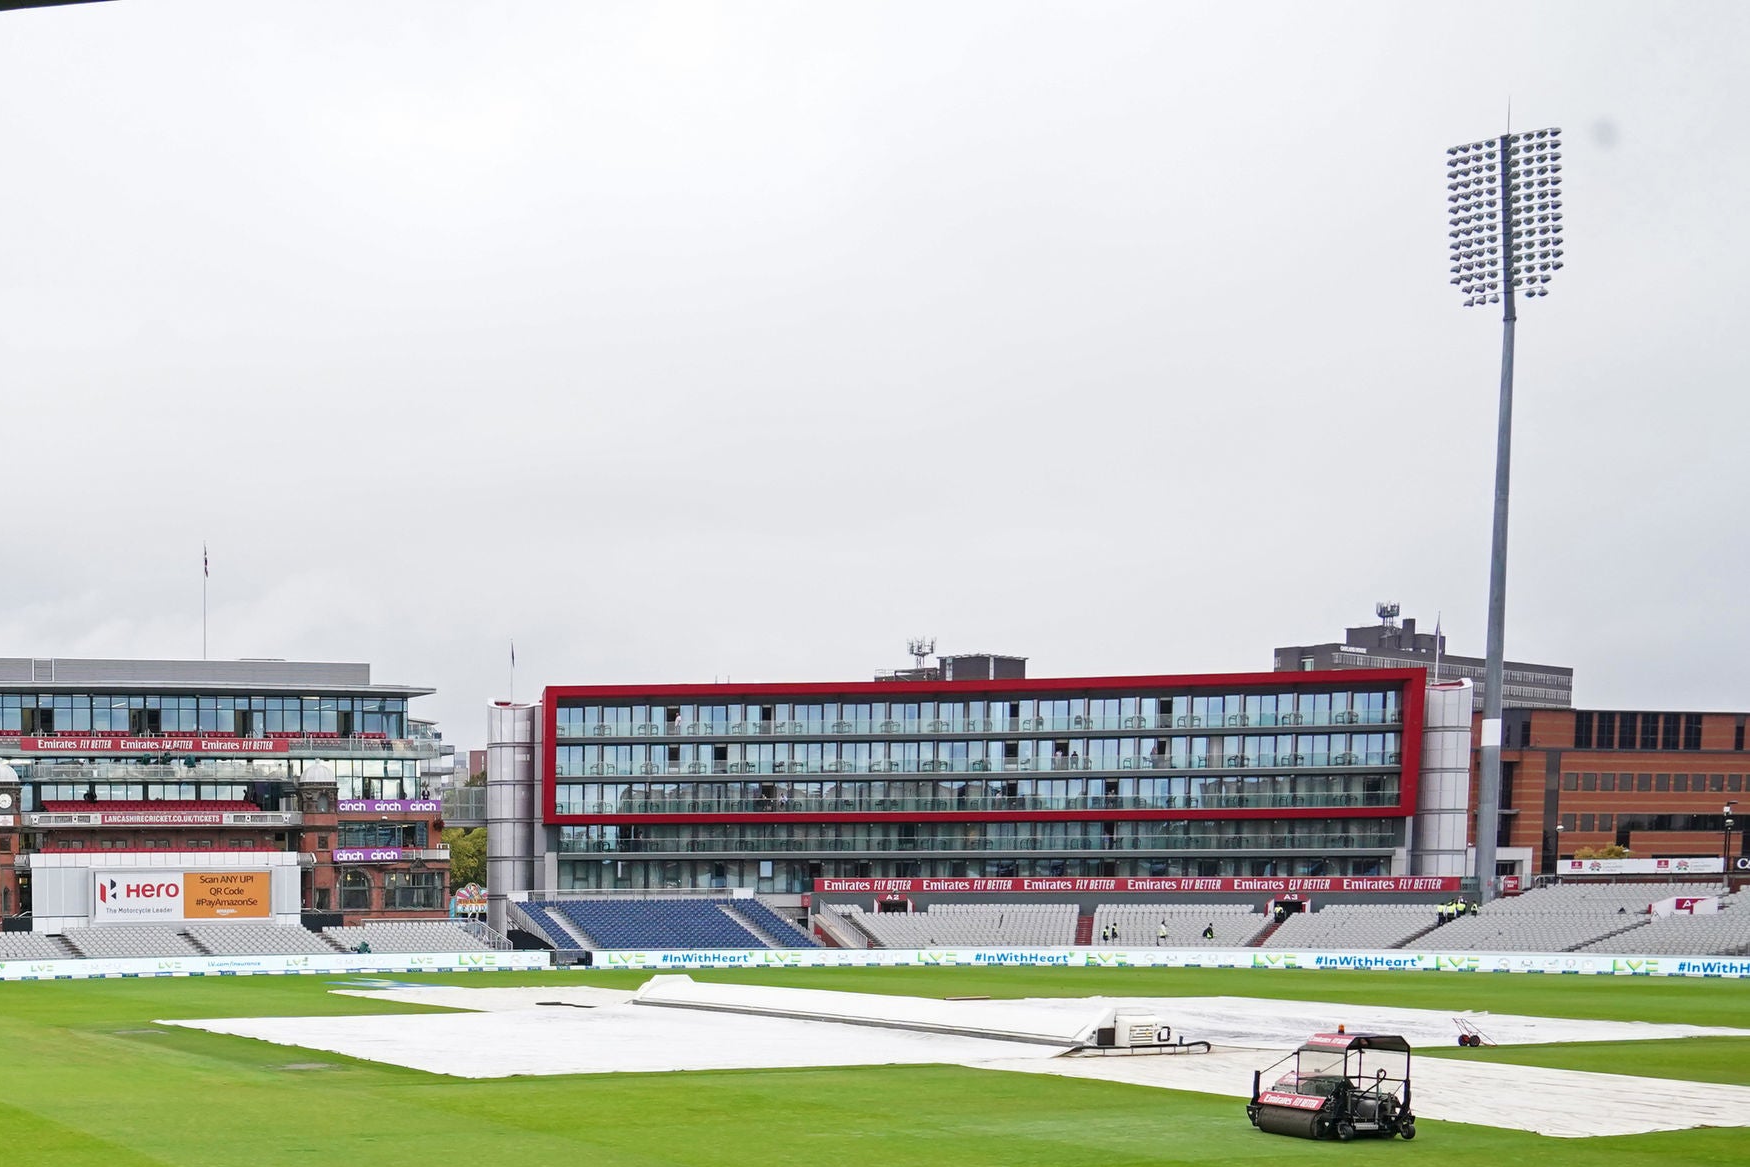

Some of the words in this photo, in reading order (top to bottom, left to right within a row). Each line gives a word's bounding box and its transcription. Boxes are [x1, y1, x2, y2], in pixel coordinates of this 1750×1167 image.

[38, 740, 77, 749] Emirates
[80, 740, 90, 749] FLY
[91, 740, 112, 749] BETTER
[120, 740, 159, 749] Emirates
[162, 740, 172, 749] FLY
[202, 740, 239, 750] Emirates
[242, 741, 252, 750] FLY
[252, 741, 273, 750] BETTER
[339, 801, 366, 811] cinch
[375, 801, 401, 811] cinch
[410, 801, 436, 811] cinch
[104, 814, 220, 822] LANCASHIRECRICKET.CO.UK/TICKETS
[337, 850, 364, 860] cinch
[371, 850, 398, 860] cinch
[824, 880, 870, 890] Emirates
[874, 880, 886, 890] FLY
[887, 880, 911, 890] BETTER
[923, 880, 970, 890] Emirates
[973, 880, 986, 890] FLY
[986, 880, 1012, 890] BETTER
[1024, 880, 1072, 890] Emirates
[1076, 880, 1089, 890] FLY
[1089, 880, 1115, 890] BETTER
[1127, 880, 1176, 890] Emirates
[1180, 880, 1194, 890] FLY
[1194, 880, 1221, 890] BETTER
[1234, 879, 1284, 890] Emirates
[1289, 879, 1302, 890] FLY
[1302, 879, 1330, 890] BETTER
[1343, 879, 1394, 890] Emirates
[1399, 879, 1413, 890] FLY
[1413, 879, 1442, 890] BETTER
[126, 883, 179, 898] Hero
[196, 898, 258, 908] #PayAmazonSe
[662, 953, 748, 962] #InWithHeart
[975, 953, 1069, 962] #InWithHeart
[1315, 956, 1417, 966] #InWithHeart
